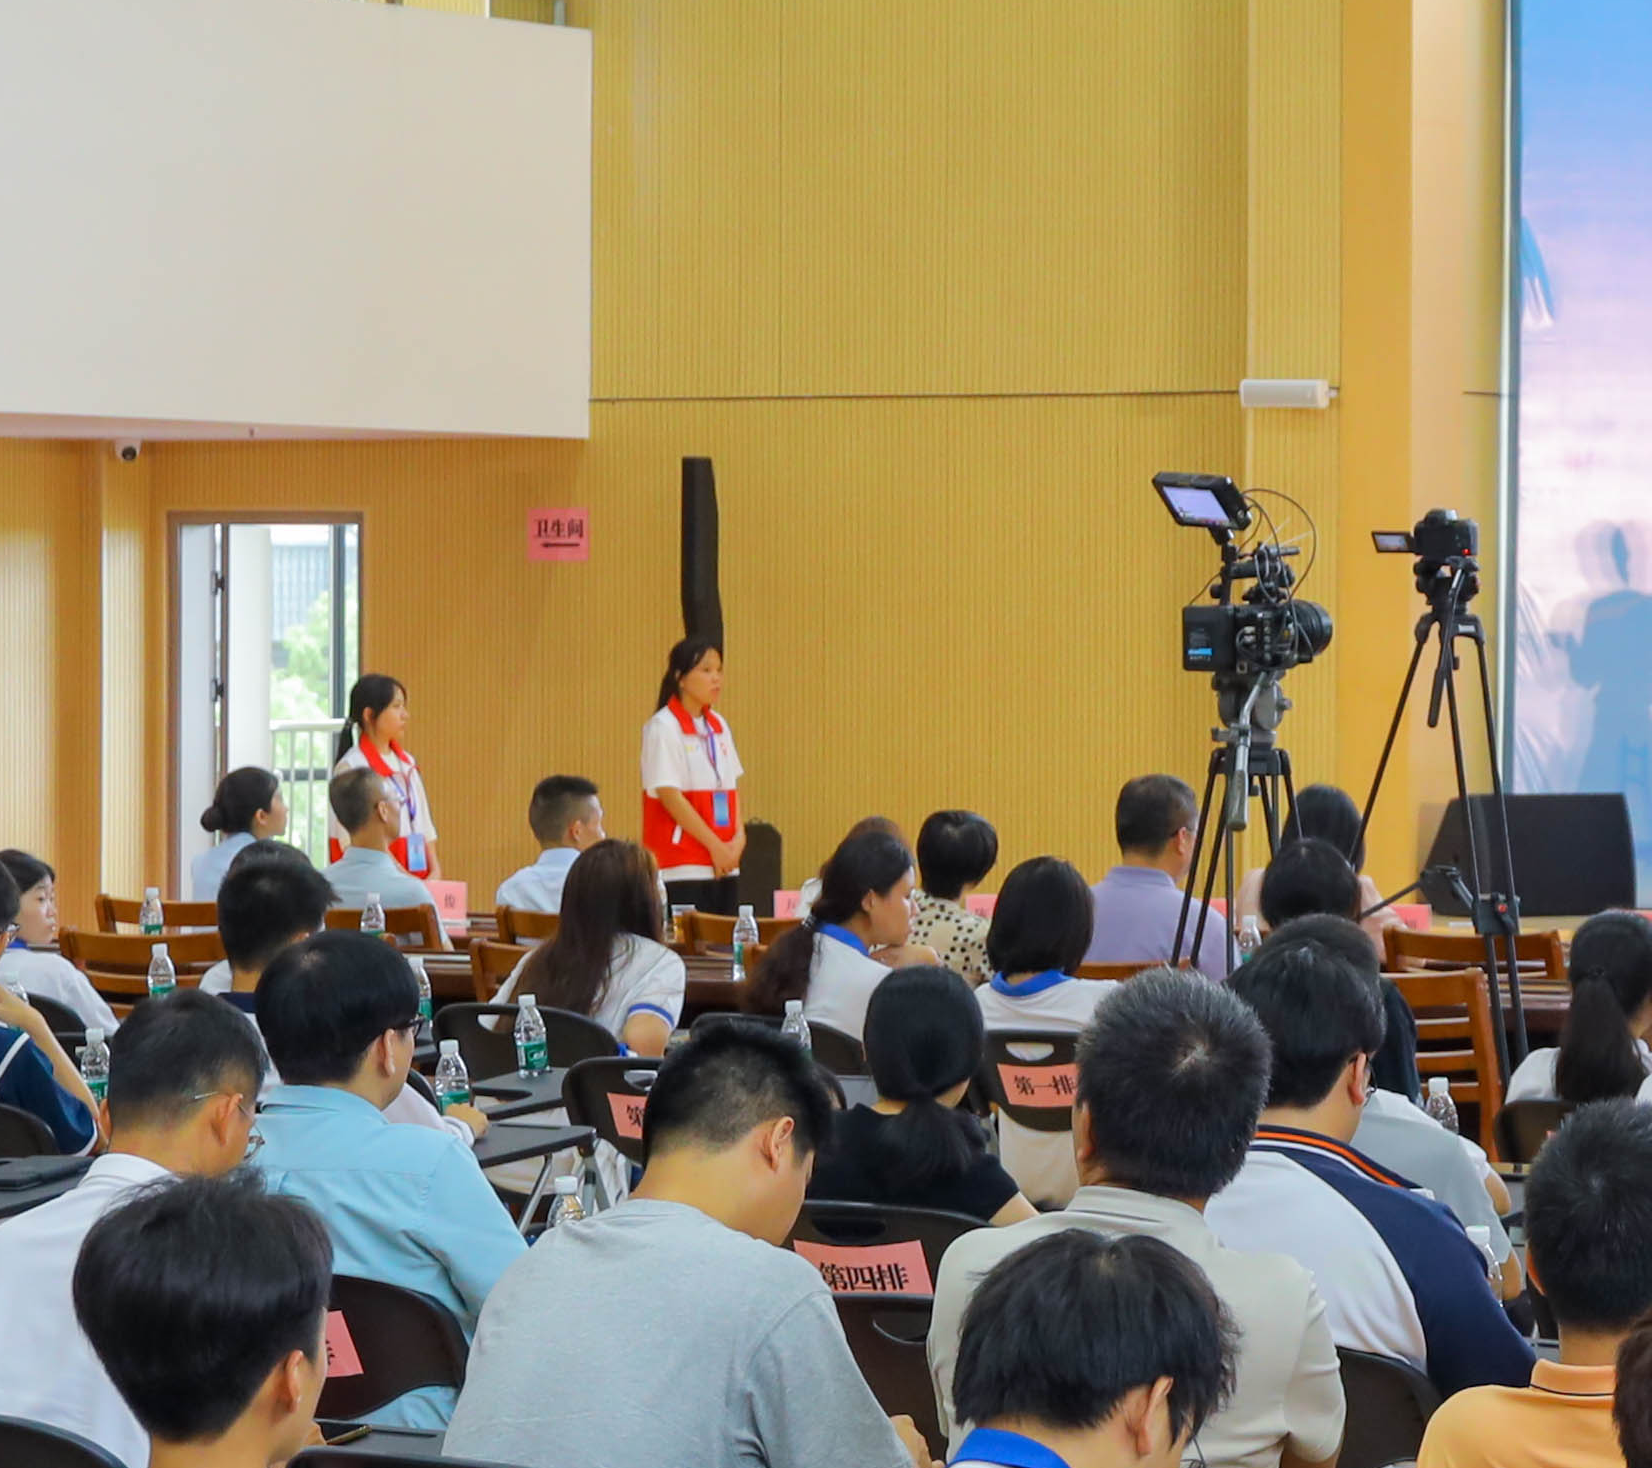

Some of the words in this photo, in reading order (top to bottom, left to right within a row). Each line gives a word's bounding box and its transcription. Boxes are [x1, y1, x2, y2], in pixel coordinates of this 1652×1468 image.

[534, 517, 585, 540] 卫生间
[1013, 1073, 1078, 1097] 第一排
[820, 1262, 910, 1292] 第四排
